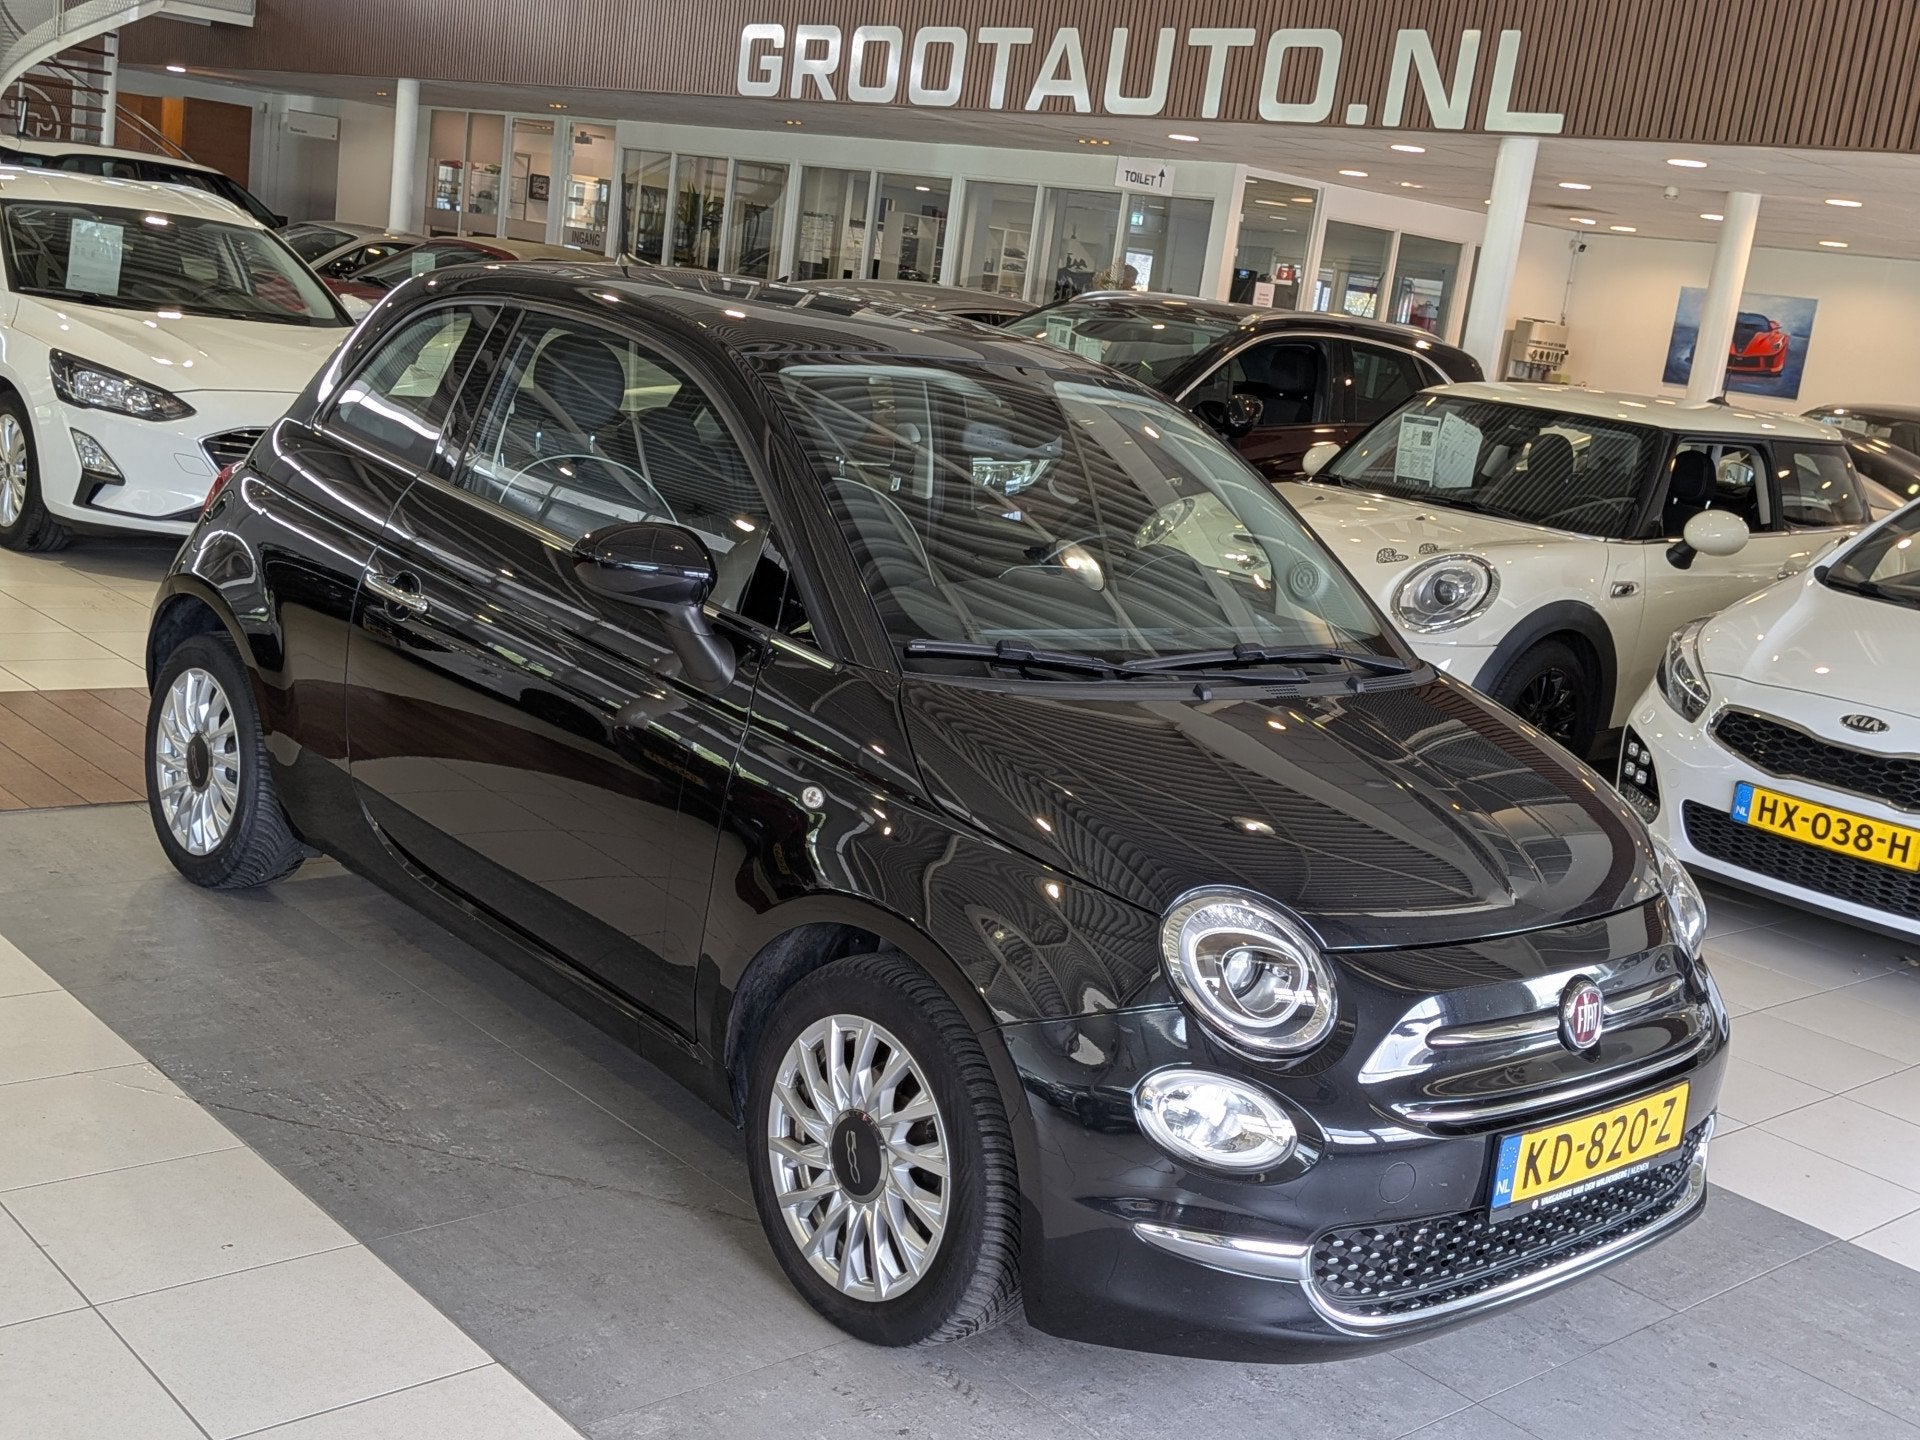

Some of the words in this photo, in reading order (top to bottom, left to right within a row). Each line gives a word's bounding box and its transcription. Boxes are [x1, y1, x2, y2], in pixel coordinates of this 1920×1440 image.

[737, 24, 1564, 133] GROOTAUTO.NL
[1125, 170, 1156, 187] TOILET
[571, 230, 600, 247] INGANG
[1846, 714, 1881, 732] KIA
[1735, 805, 1748, 817] NL
[1757, 795, 1912, 863] HX-038-H
[1577, 1002, 1599, 1034] FIAT
[1522, 1096, 1677, 1190] KD-820-Z
[1495, 1178, 1511, 1196] NL
